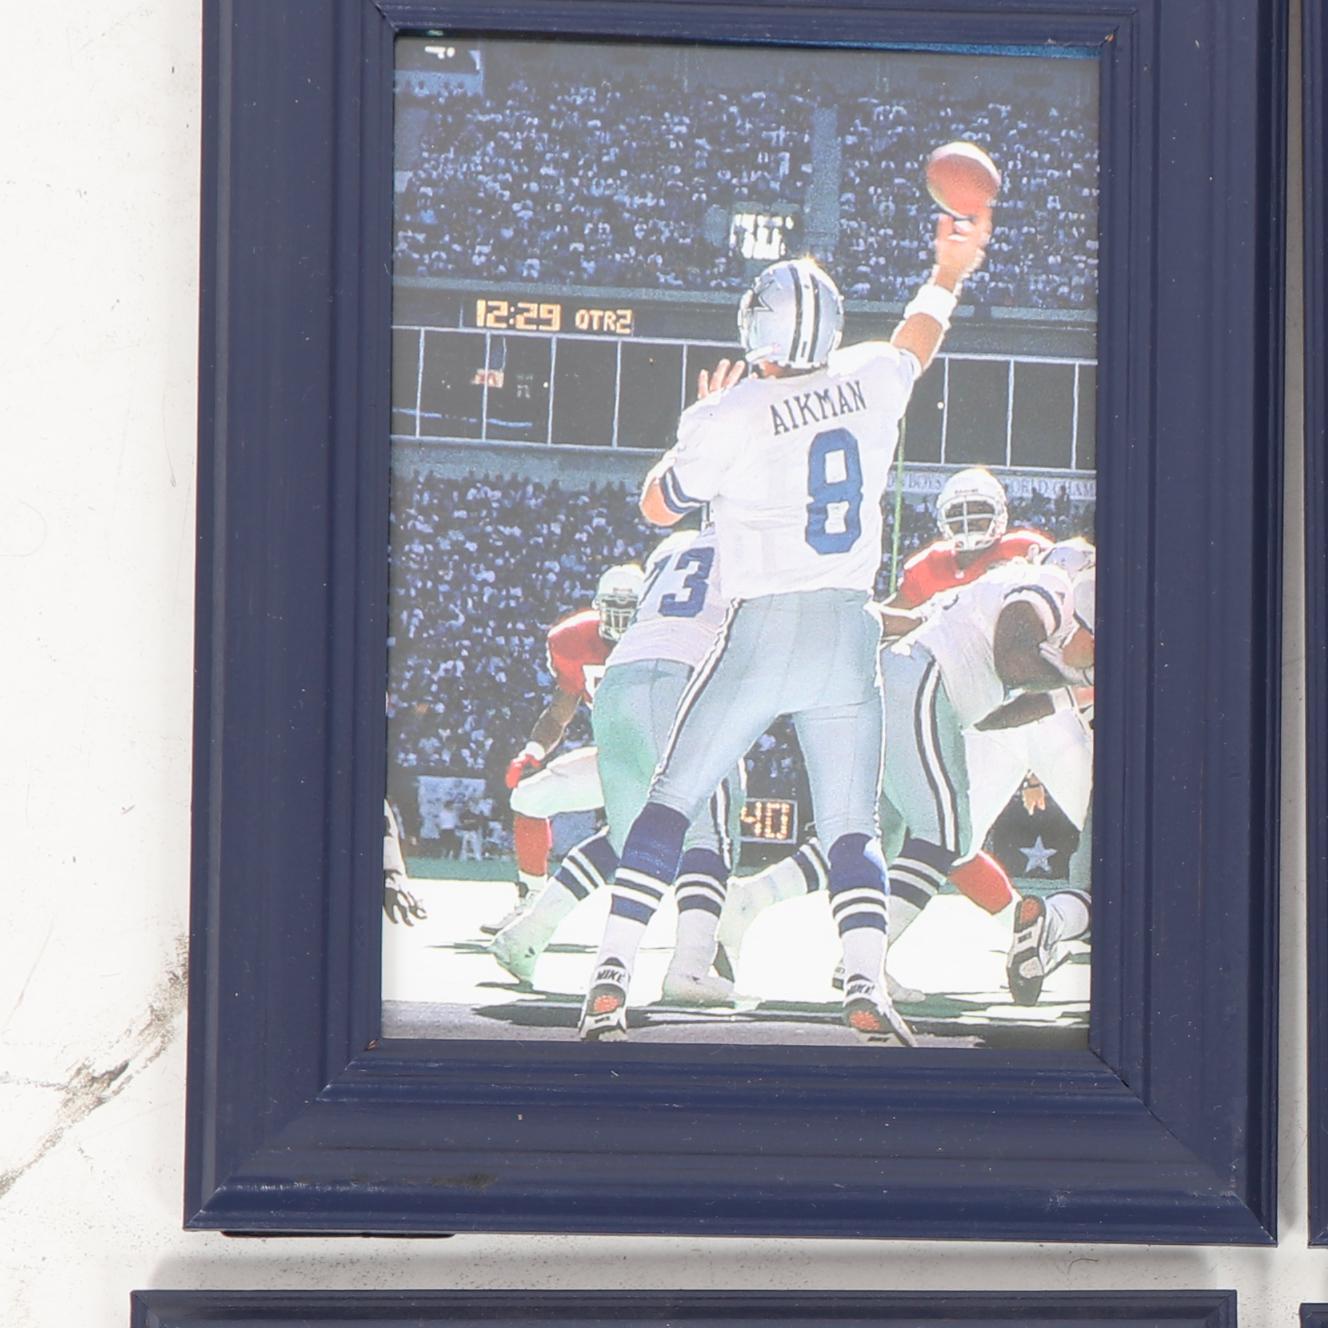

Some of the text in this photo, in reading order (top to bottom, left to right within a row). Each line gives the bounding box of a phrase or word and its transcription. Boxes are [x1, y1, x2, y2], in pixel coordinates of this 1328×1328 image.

[475, 299, 562, 332] 12:29
[770, 379, 867, 436] AIKMAN
[804, 427, 864, 556] 8
[740, 801, 791, 839] 40
